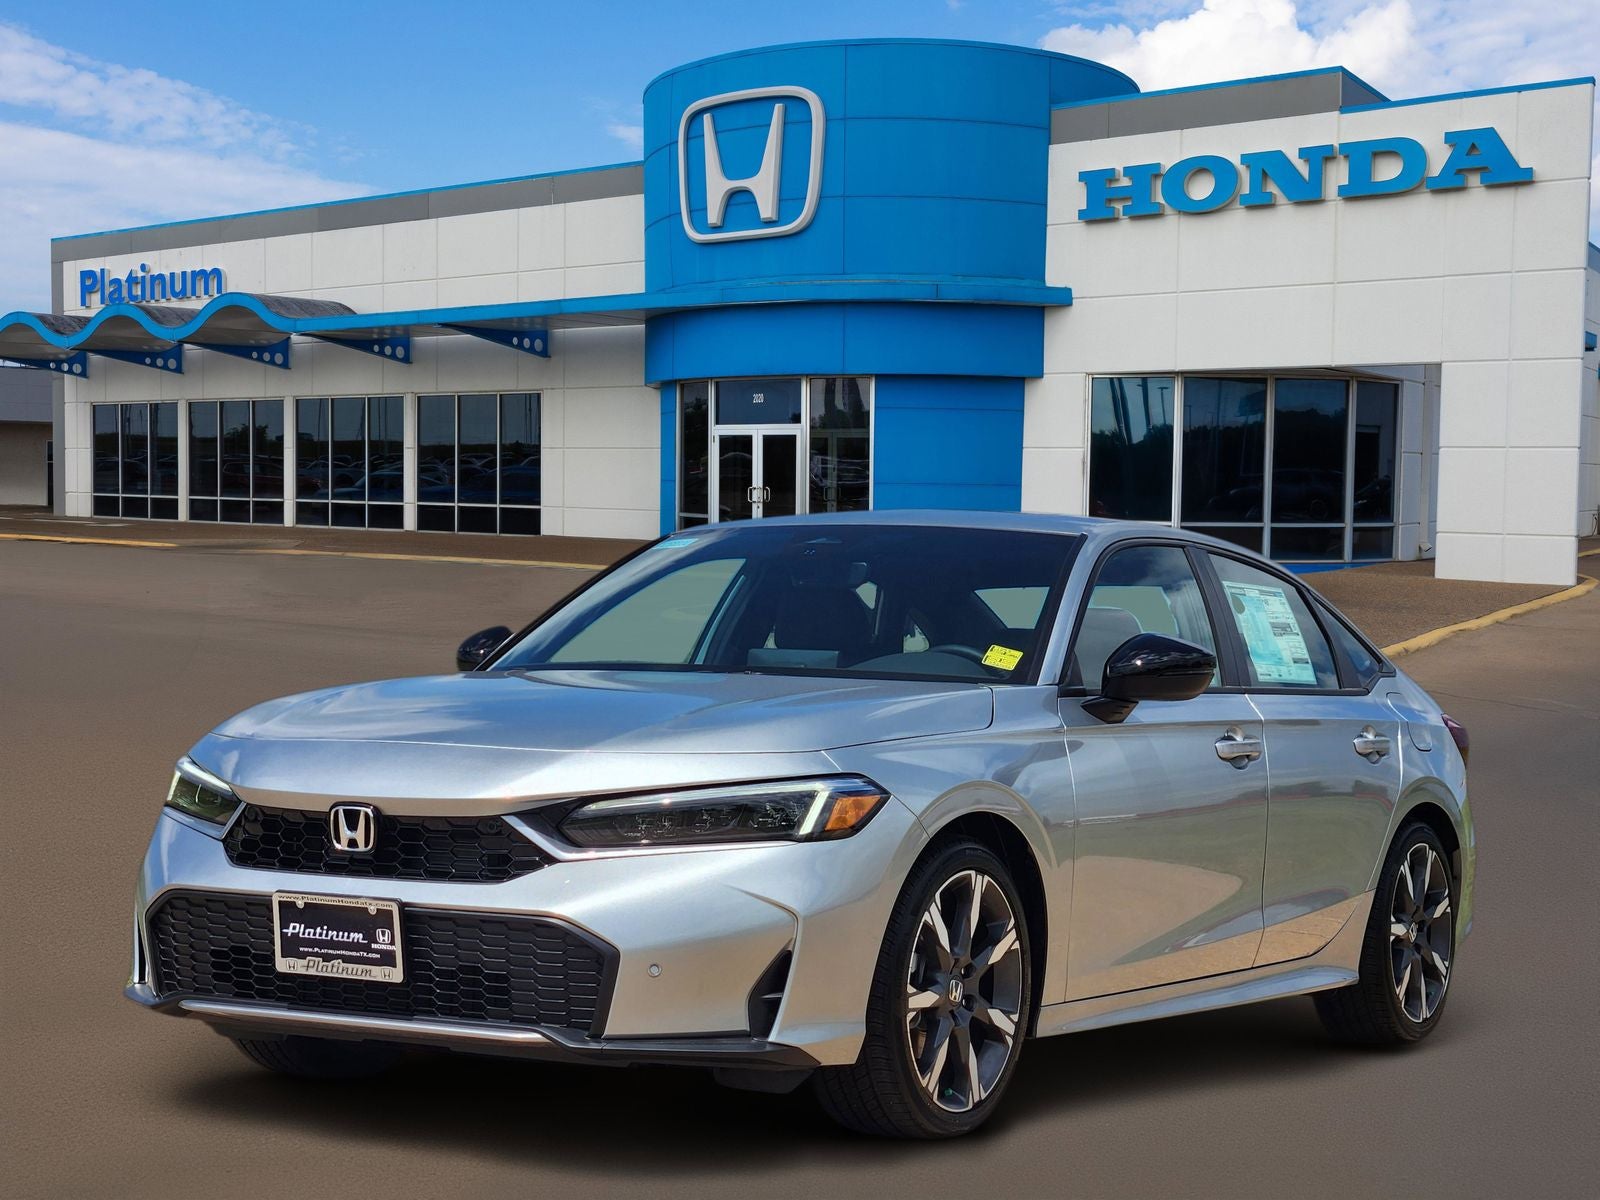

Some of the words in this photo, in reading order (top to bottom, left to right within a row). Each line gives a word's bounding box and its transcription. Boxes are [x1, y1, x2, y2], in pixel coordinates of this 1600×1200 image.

[1078, 127, 1534, 221] HONDA
[79, 263, 223, 307] Platinum
[282, 923, 368, 943] Platinum
[300, 958, 378, 978] Platinum
